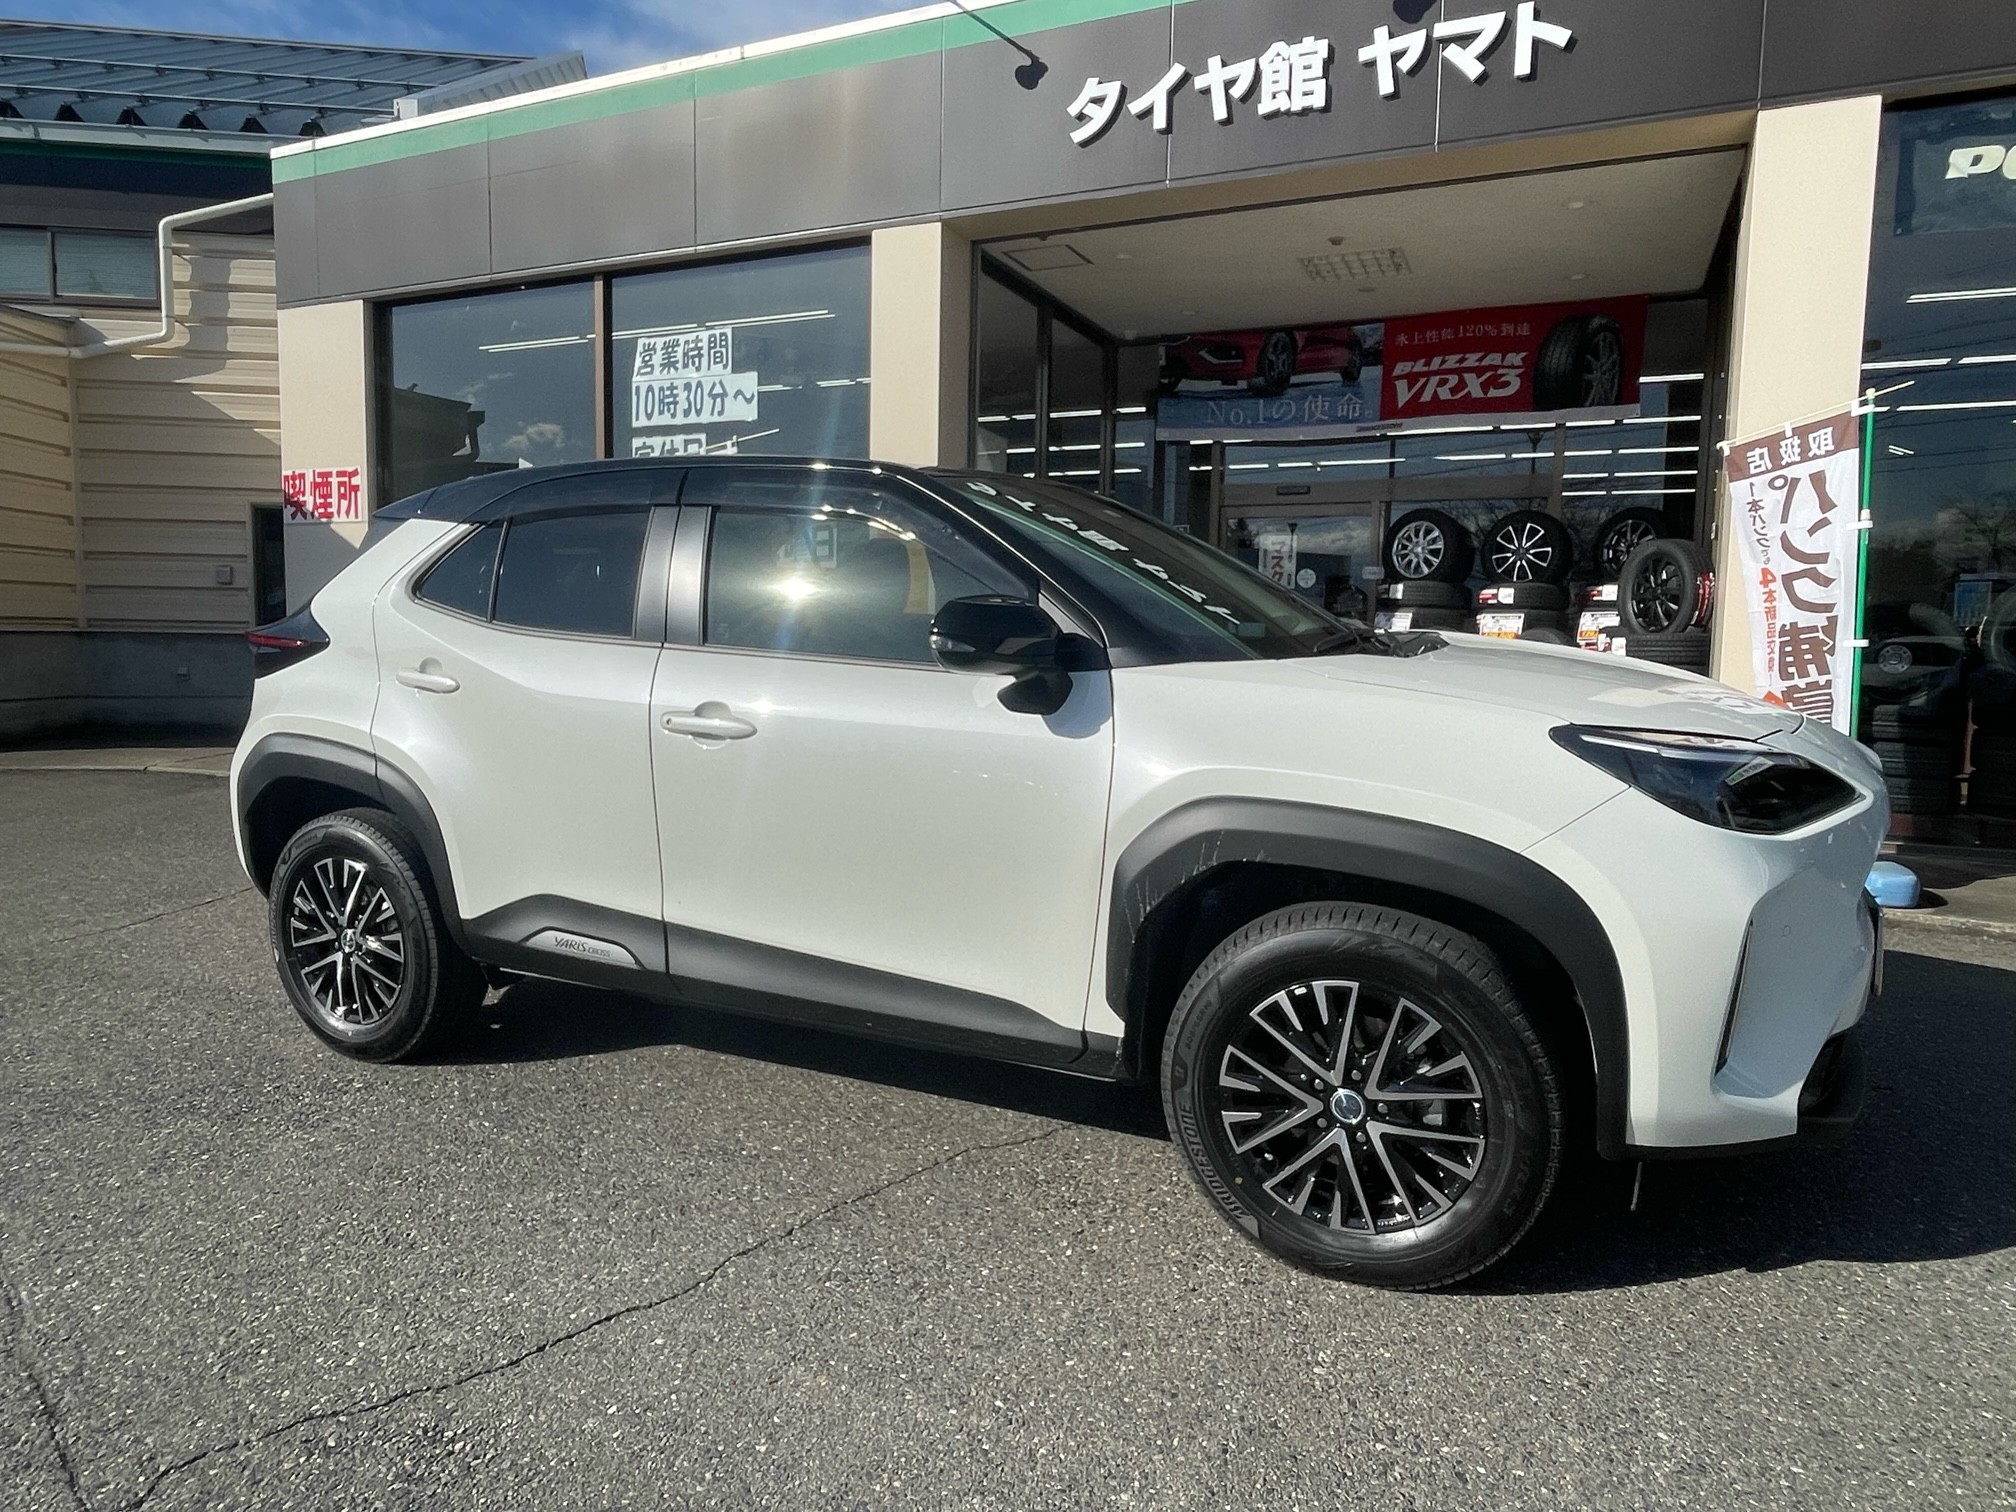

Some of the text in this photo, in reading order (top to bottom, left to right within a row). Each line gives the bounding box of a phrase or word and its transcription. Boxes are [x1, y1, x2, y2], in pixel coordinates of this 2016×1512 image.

[1067, 1, 1574, 146] タイヤ館 ヤマト
[635, 332, 731, 378] 営業時間
[1392, 352, 1529, 377] BLIZZAK
[1393, 367, 1525, 410] VRX3
[283, 468, 361, 521] 喫煙所
[1178, 1101, 1252, 1221] BRIDGESTONE
